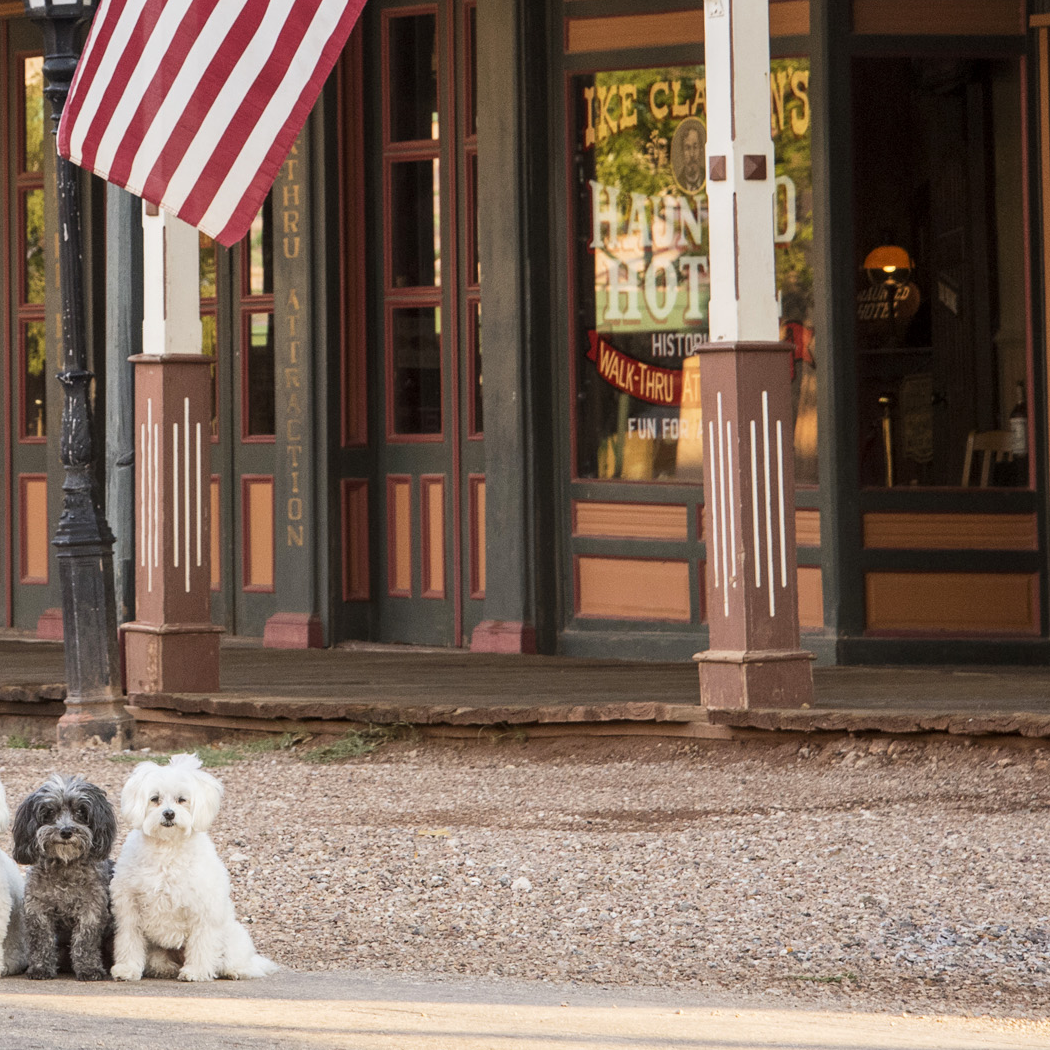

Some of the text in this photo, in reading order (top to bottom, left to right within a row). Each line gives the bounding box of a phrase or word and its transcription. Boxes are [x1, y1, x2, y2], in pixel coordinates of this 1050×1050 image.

[584, 83, 638, 148] IKE
[589, 174, 797, 250] HAUND
[600, 341, 674, 403] WALK-THRU
[627, 417, 657, 440] FUN
[662, 417, 689, 440] FOR
